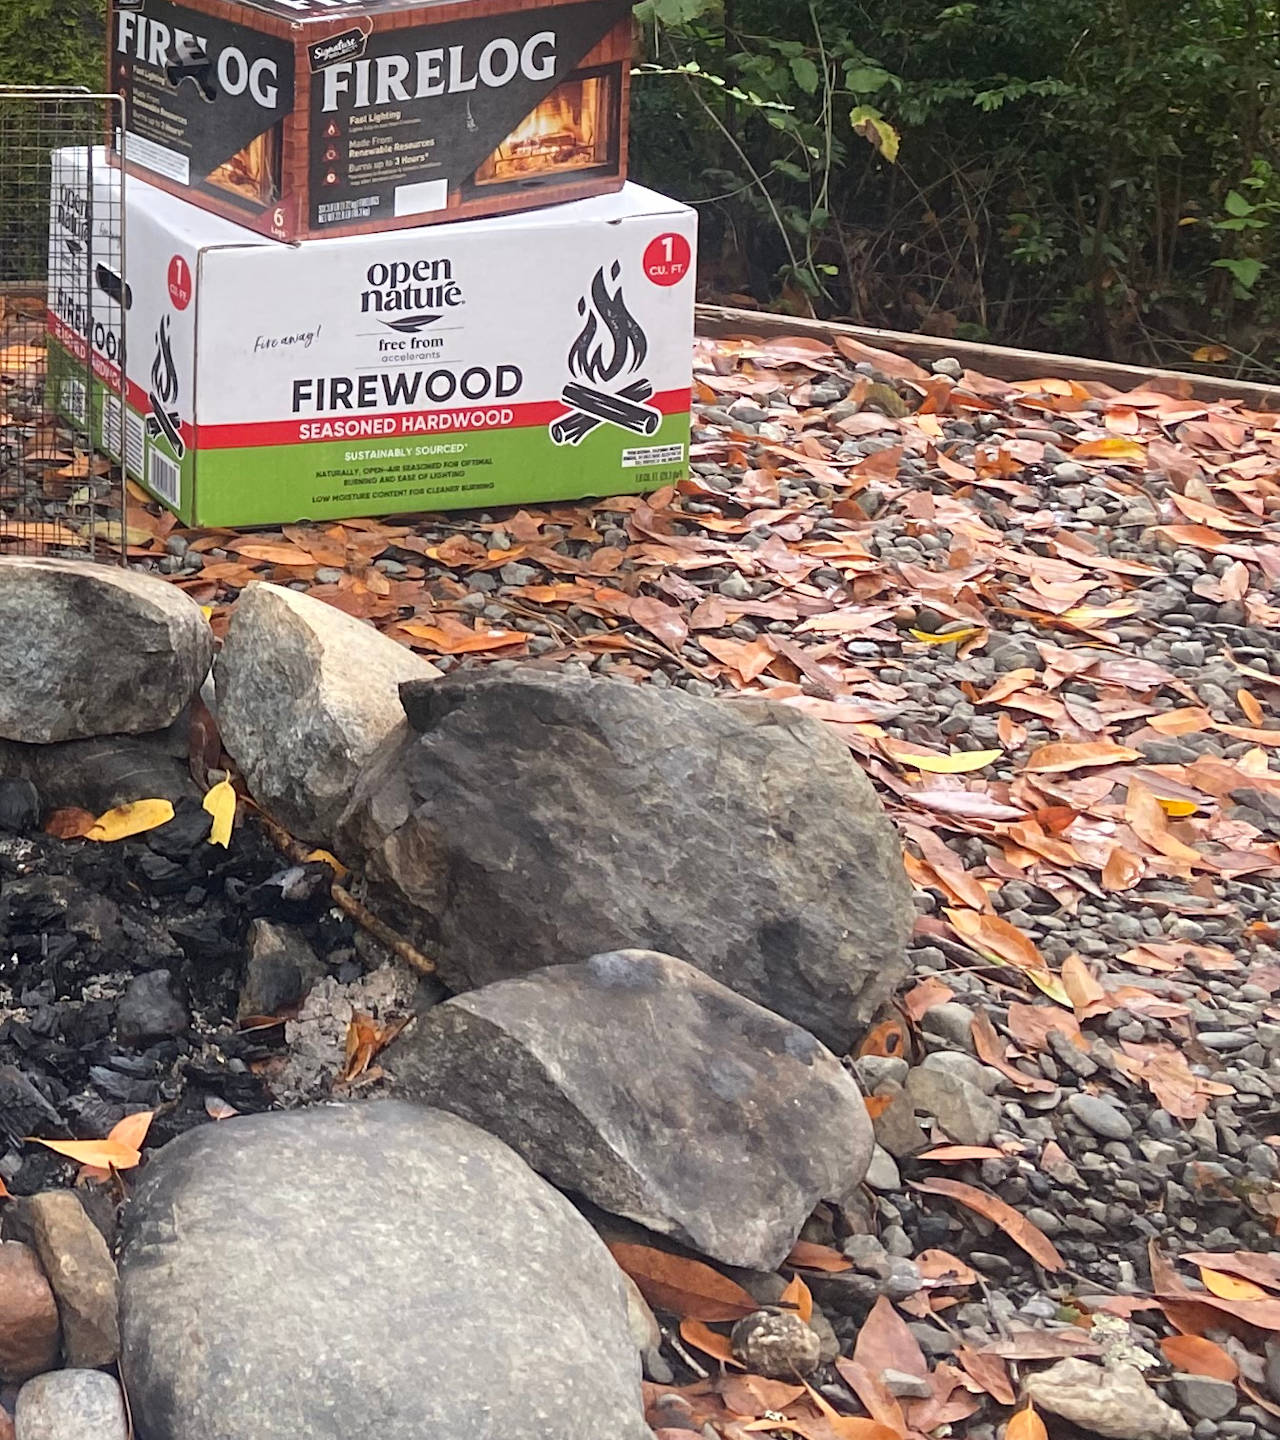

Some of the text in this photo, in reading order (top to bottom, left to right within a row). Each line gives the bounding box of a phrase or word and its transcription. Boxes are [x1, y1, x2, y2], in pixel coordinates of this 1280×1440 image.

[117, 11, 278, 109] FIREOG
[313, 38, 357, 61] Signature
[321, 31, 557, 112] FIRELOG
[349, 111, 401, 125] Fast Lighting
[274, 208, 285, 227] 6
[661, 237, 673, 262] 1
[176, 259, 182, 285] 1
[366, 258, 452, 288] open
[670, 263, 684, 274] FT.
[360, 280, 463, 313] nature
[253, 324, 322, 353] Fire away!
[378, 337, 444, 352] free from
[381, 351, 441, 363] accelerants
[291, 364, 523, 413] FIREWOOD
[299, 409, 513, 440] SEASONED HARDWOOD
[344, 447, 414, 461] SUSTAINABLY
[315, 458, 494, 478] NATURALLY, OPEN-AIR SEASONED FOR OPTIMAL
[343, 478, 378, 486] BURNING
[379, 476, 396, 484] AND
[397, 474, 416, 482] EASE
[429, 470, 465, 479] LIGHTING
[312, 482, 495, 504] LOW MOISTURE CONTENT FOR CLEANER BURNING
